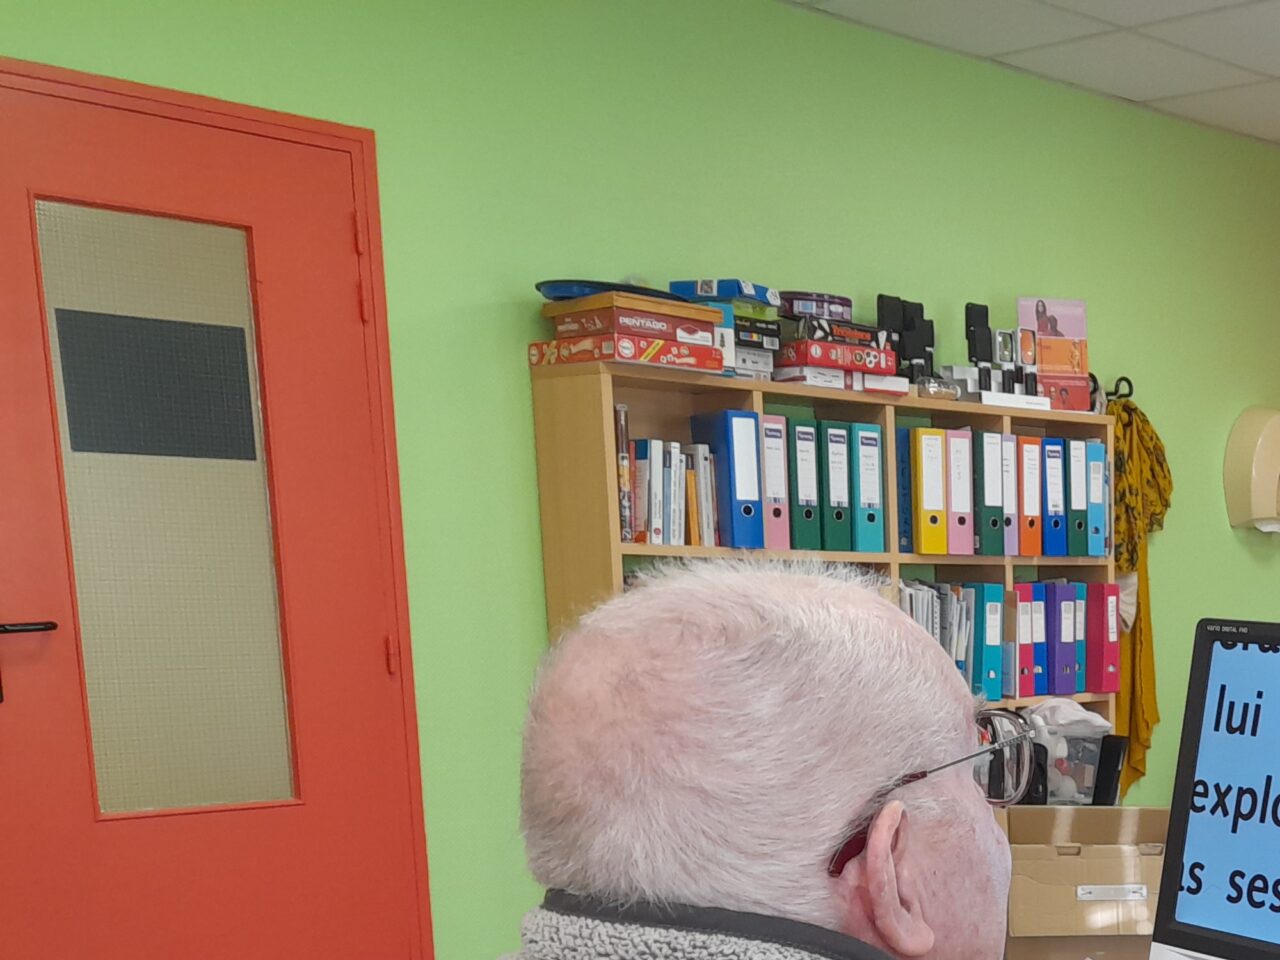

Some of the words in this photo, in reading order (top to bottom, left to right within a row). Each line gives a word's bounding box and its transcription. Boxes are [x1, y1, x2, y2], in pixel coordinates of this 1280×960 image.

[619, 316, 667, 331] PENTAGO
[1213, 684, 1264, 737] lui
[1177, 861, 1205, 895] s
